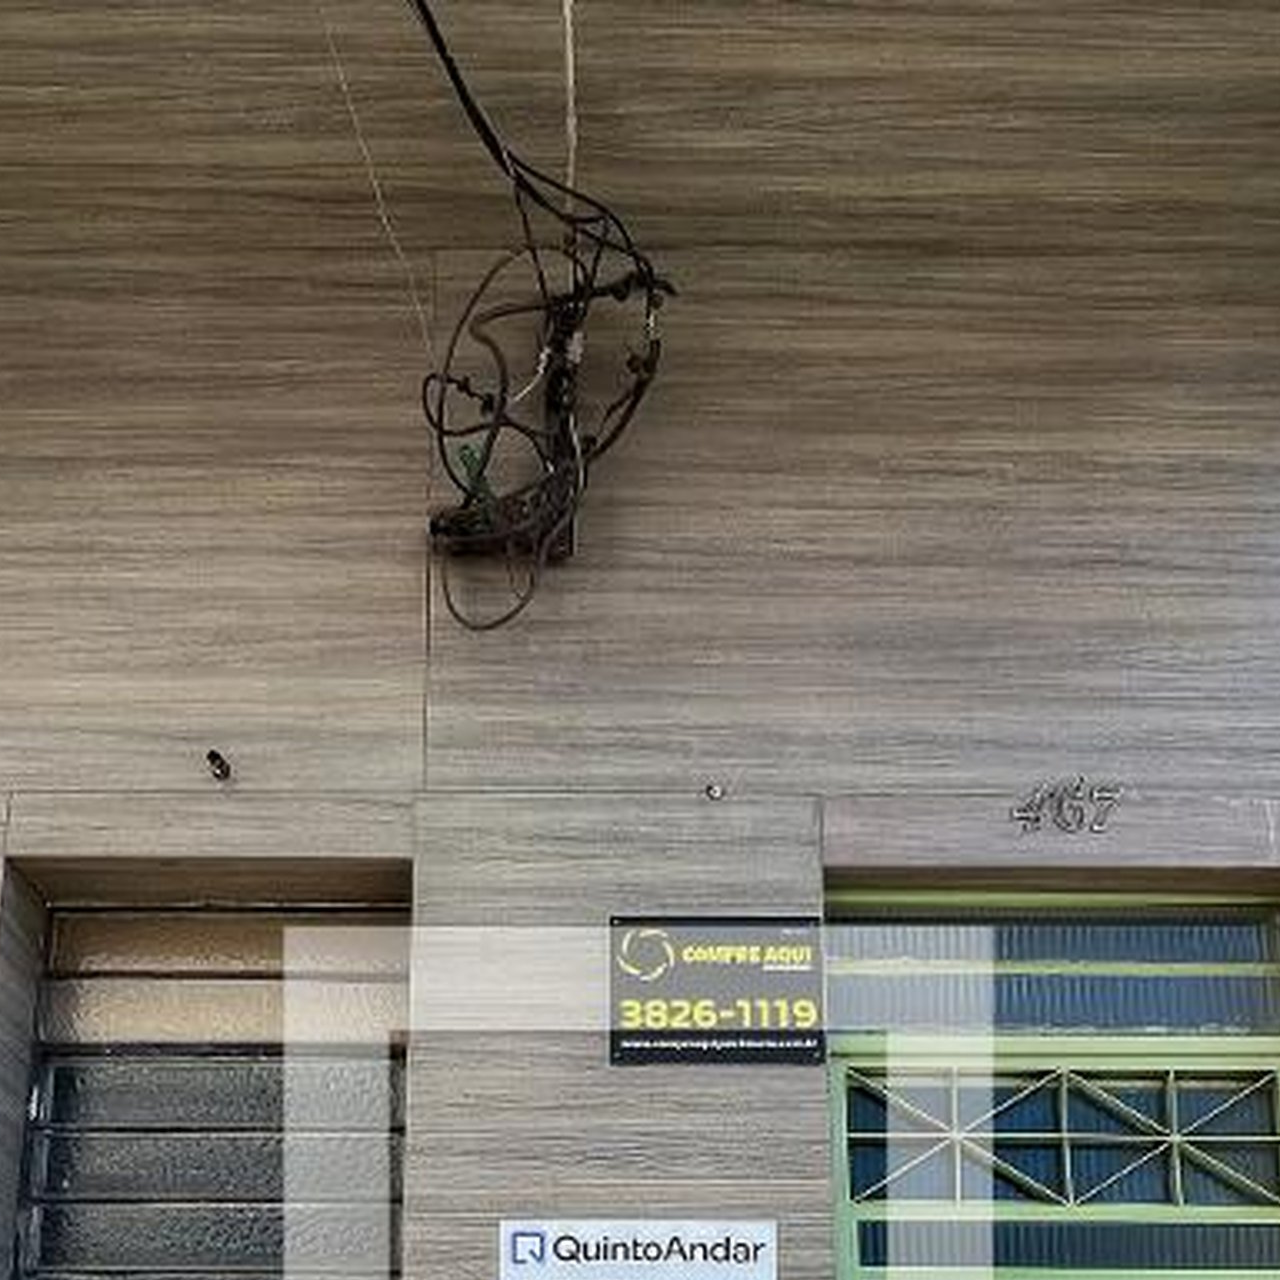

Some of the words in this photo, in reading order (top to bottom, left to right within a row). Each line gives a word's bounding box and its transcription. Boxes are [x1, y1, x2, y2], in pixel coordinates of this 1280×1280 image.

[682, 946, 759, 964] COMPRE
[763, 946, 812, 964] AQUI
[620, 999, 818, 1029] 3826-1119
[552, 1236, 766, 1263] QuintoAndar
